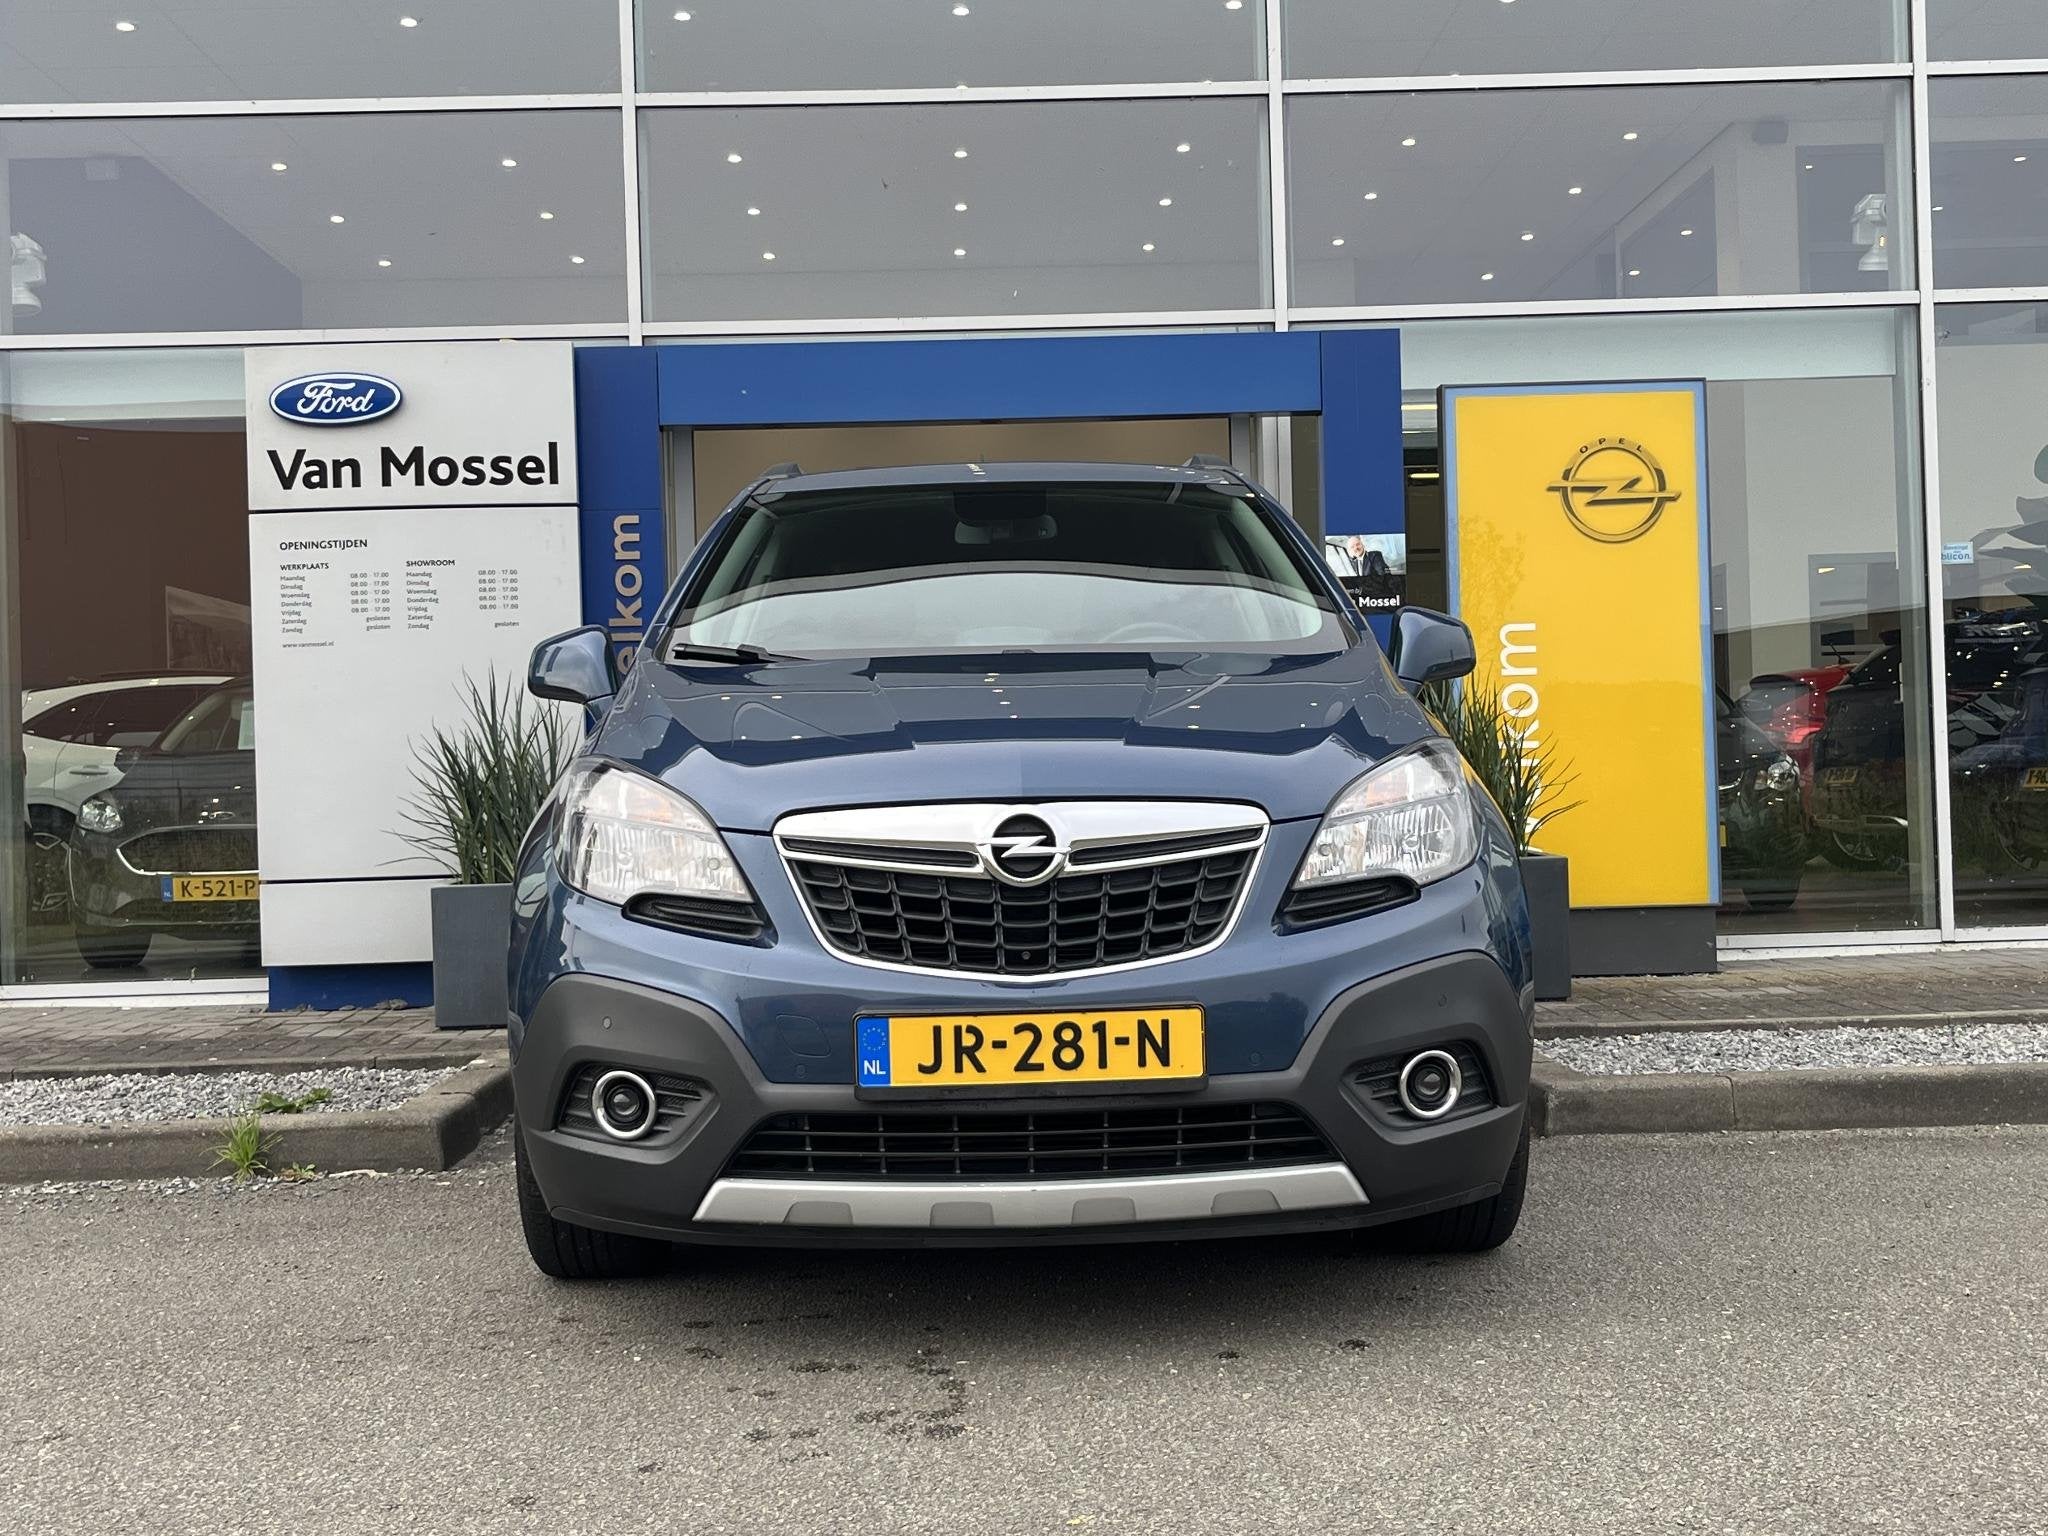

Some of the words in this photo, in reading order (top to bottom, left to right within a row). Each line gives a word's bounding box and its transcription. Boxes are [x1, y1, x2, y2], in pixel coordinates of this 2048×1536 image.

[297, 380, 375, 414] Ford
[1579, 437, 1643, 454] OPEL
[266, 448, 361, 490] Van
[380, 441, 559, 487] Mossel
[280, 539, 368, 550] OPENINGSTIJDEN
[280, 562, 329, 571] WERKPLAATS
[406, 559, 456, 567] SHOWROOM
[609, 514, 643, 676] elkom
[1359, 594, 1400, 608] Mossel
[181, 879, 256, 897] K-521-P
[864, 1059, 887, 1075] NL
[917, 1018, 1171, 1075] JR-281-N
